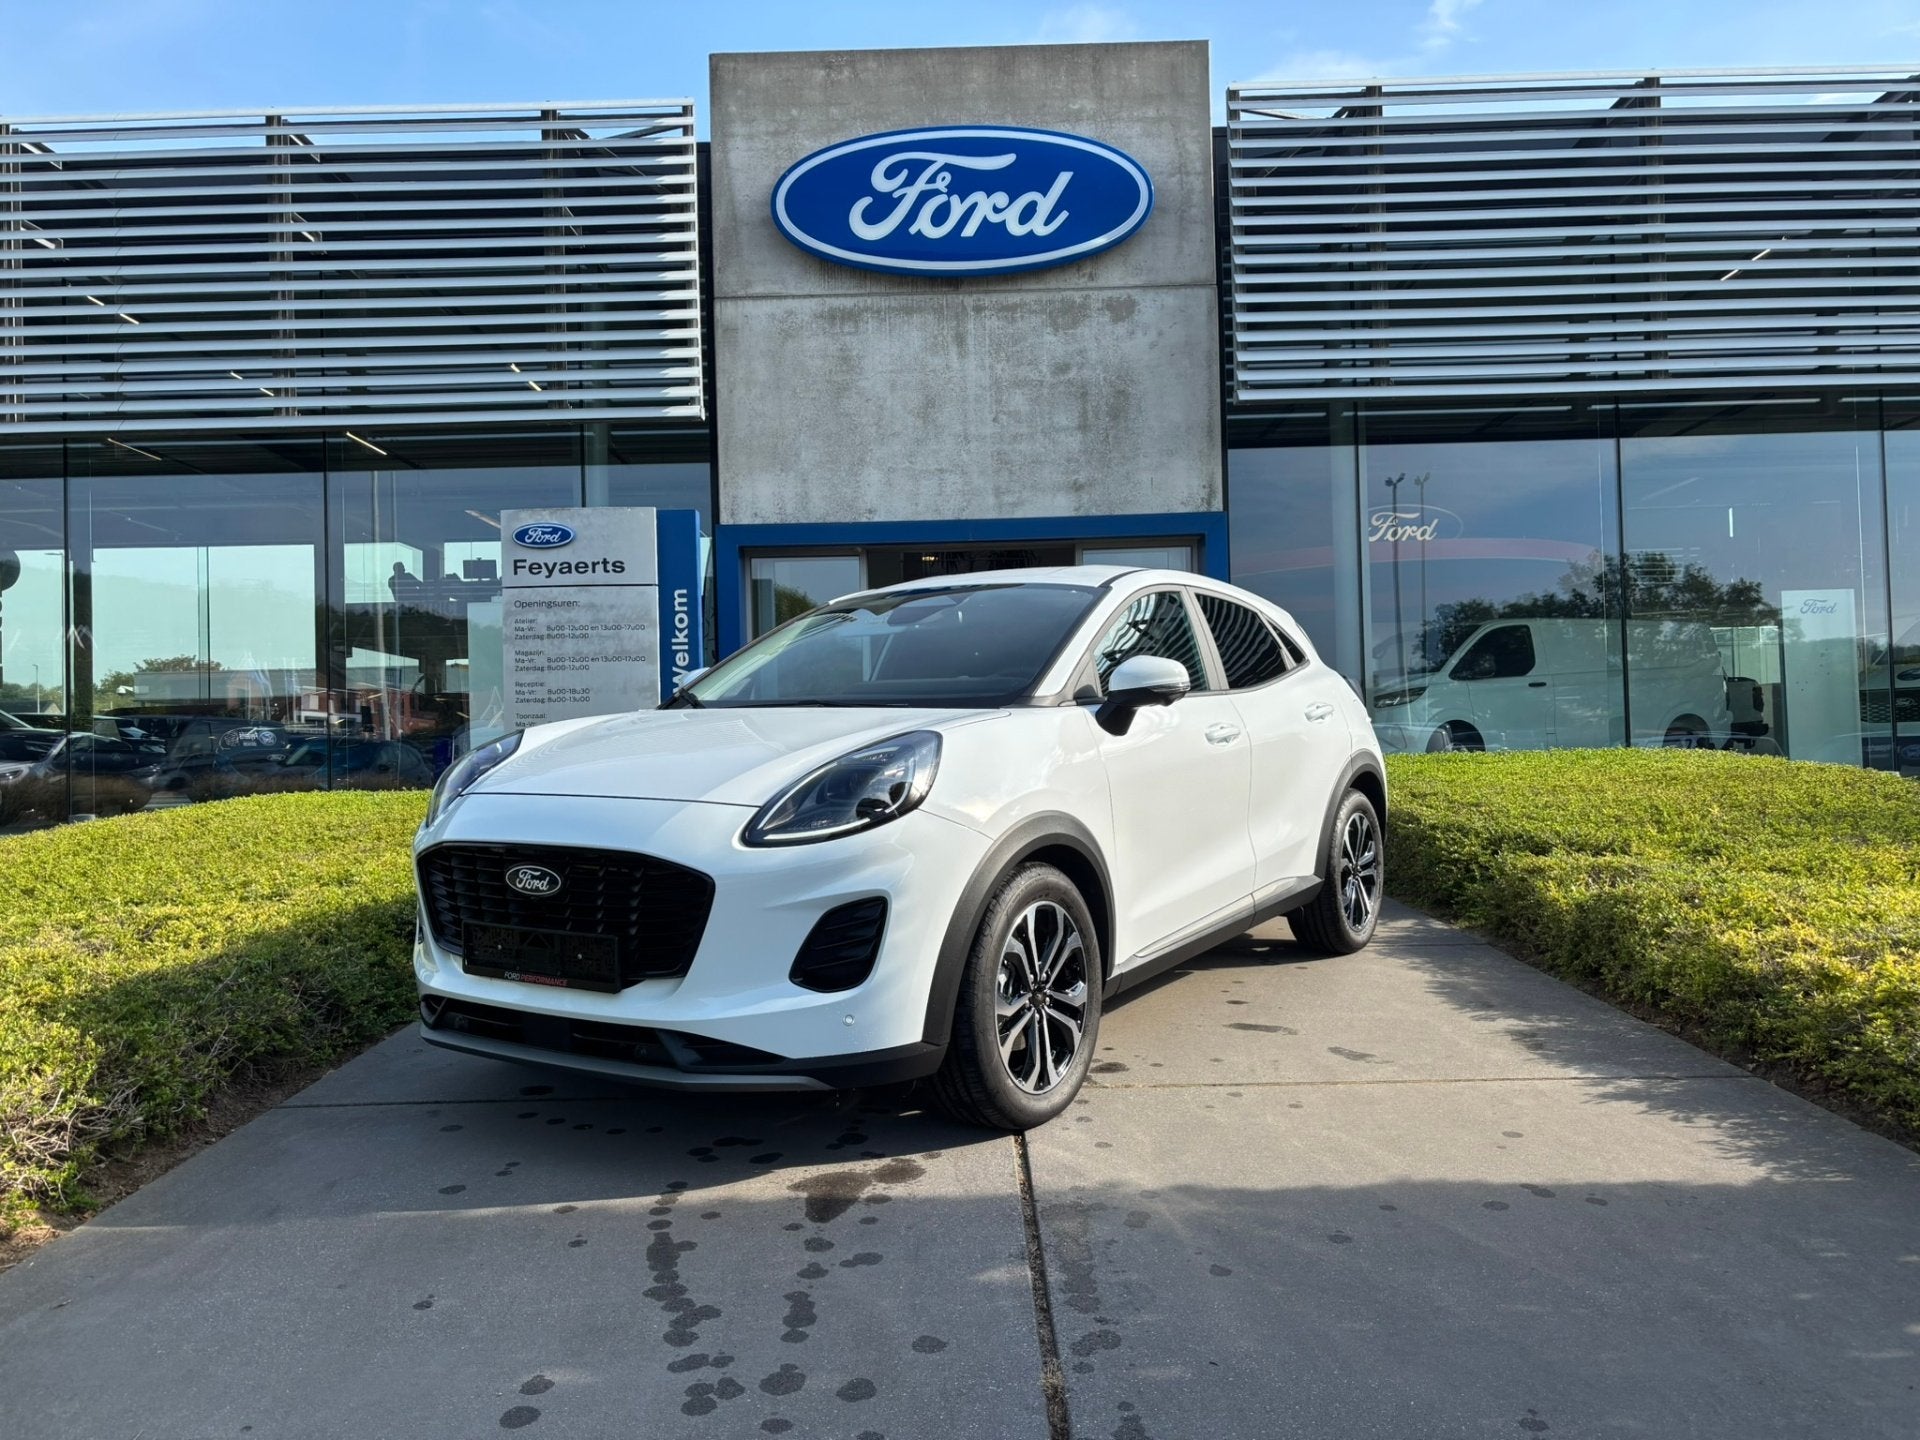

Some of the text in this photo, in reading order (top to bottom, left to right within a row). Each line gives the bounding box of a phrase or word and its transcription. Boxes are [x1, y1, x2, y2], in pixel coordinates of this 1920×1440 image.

[848, 151, 1074, 241] Ford
[524, 527, 562, 543] Ford
[1368, 511, 1439, 542] Ford
[513, 557, 626, 579] Feyaerts
[513, 600, 581, 609] Openingsuren:
[1800, 598, 1838, 615] Ford
[516, 869, 550, 891] Ford
[504, 971, 568, 987] FORD PERFORMANCE
